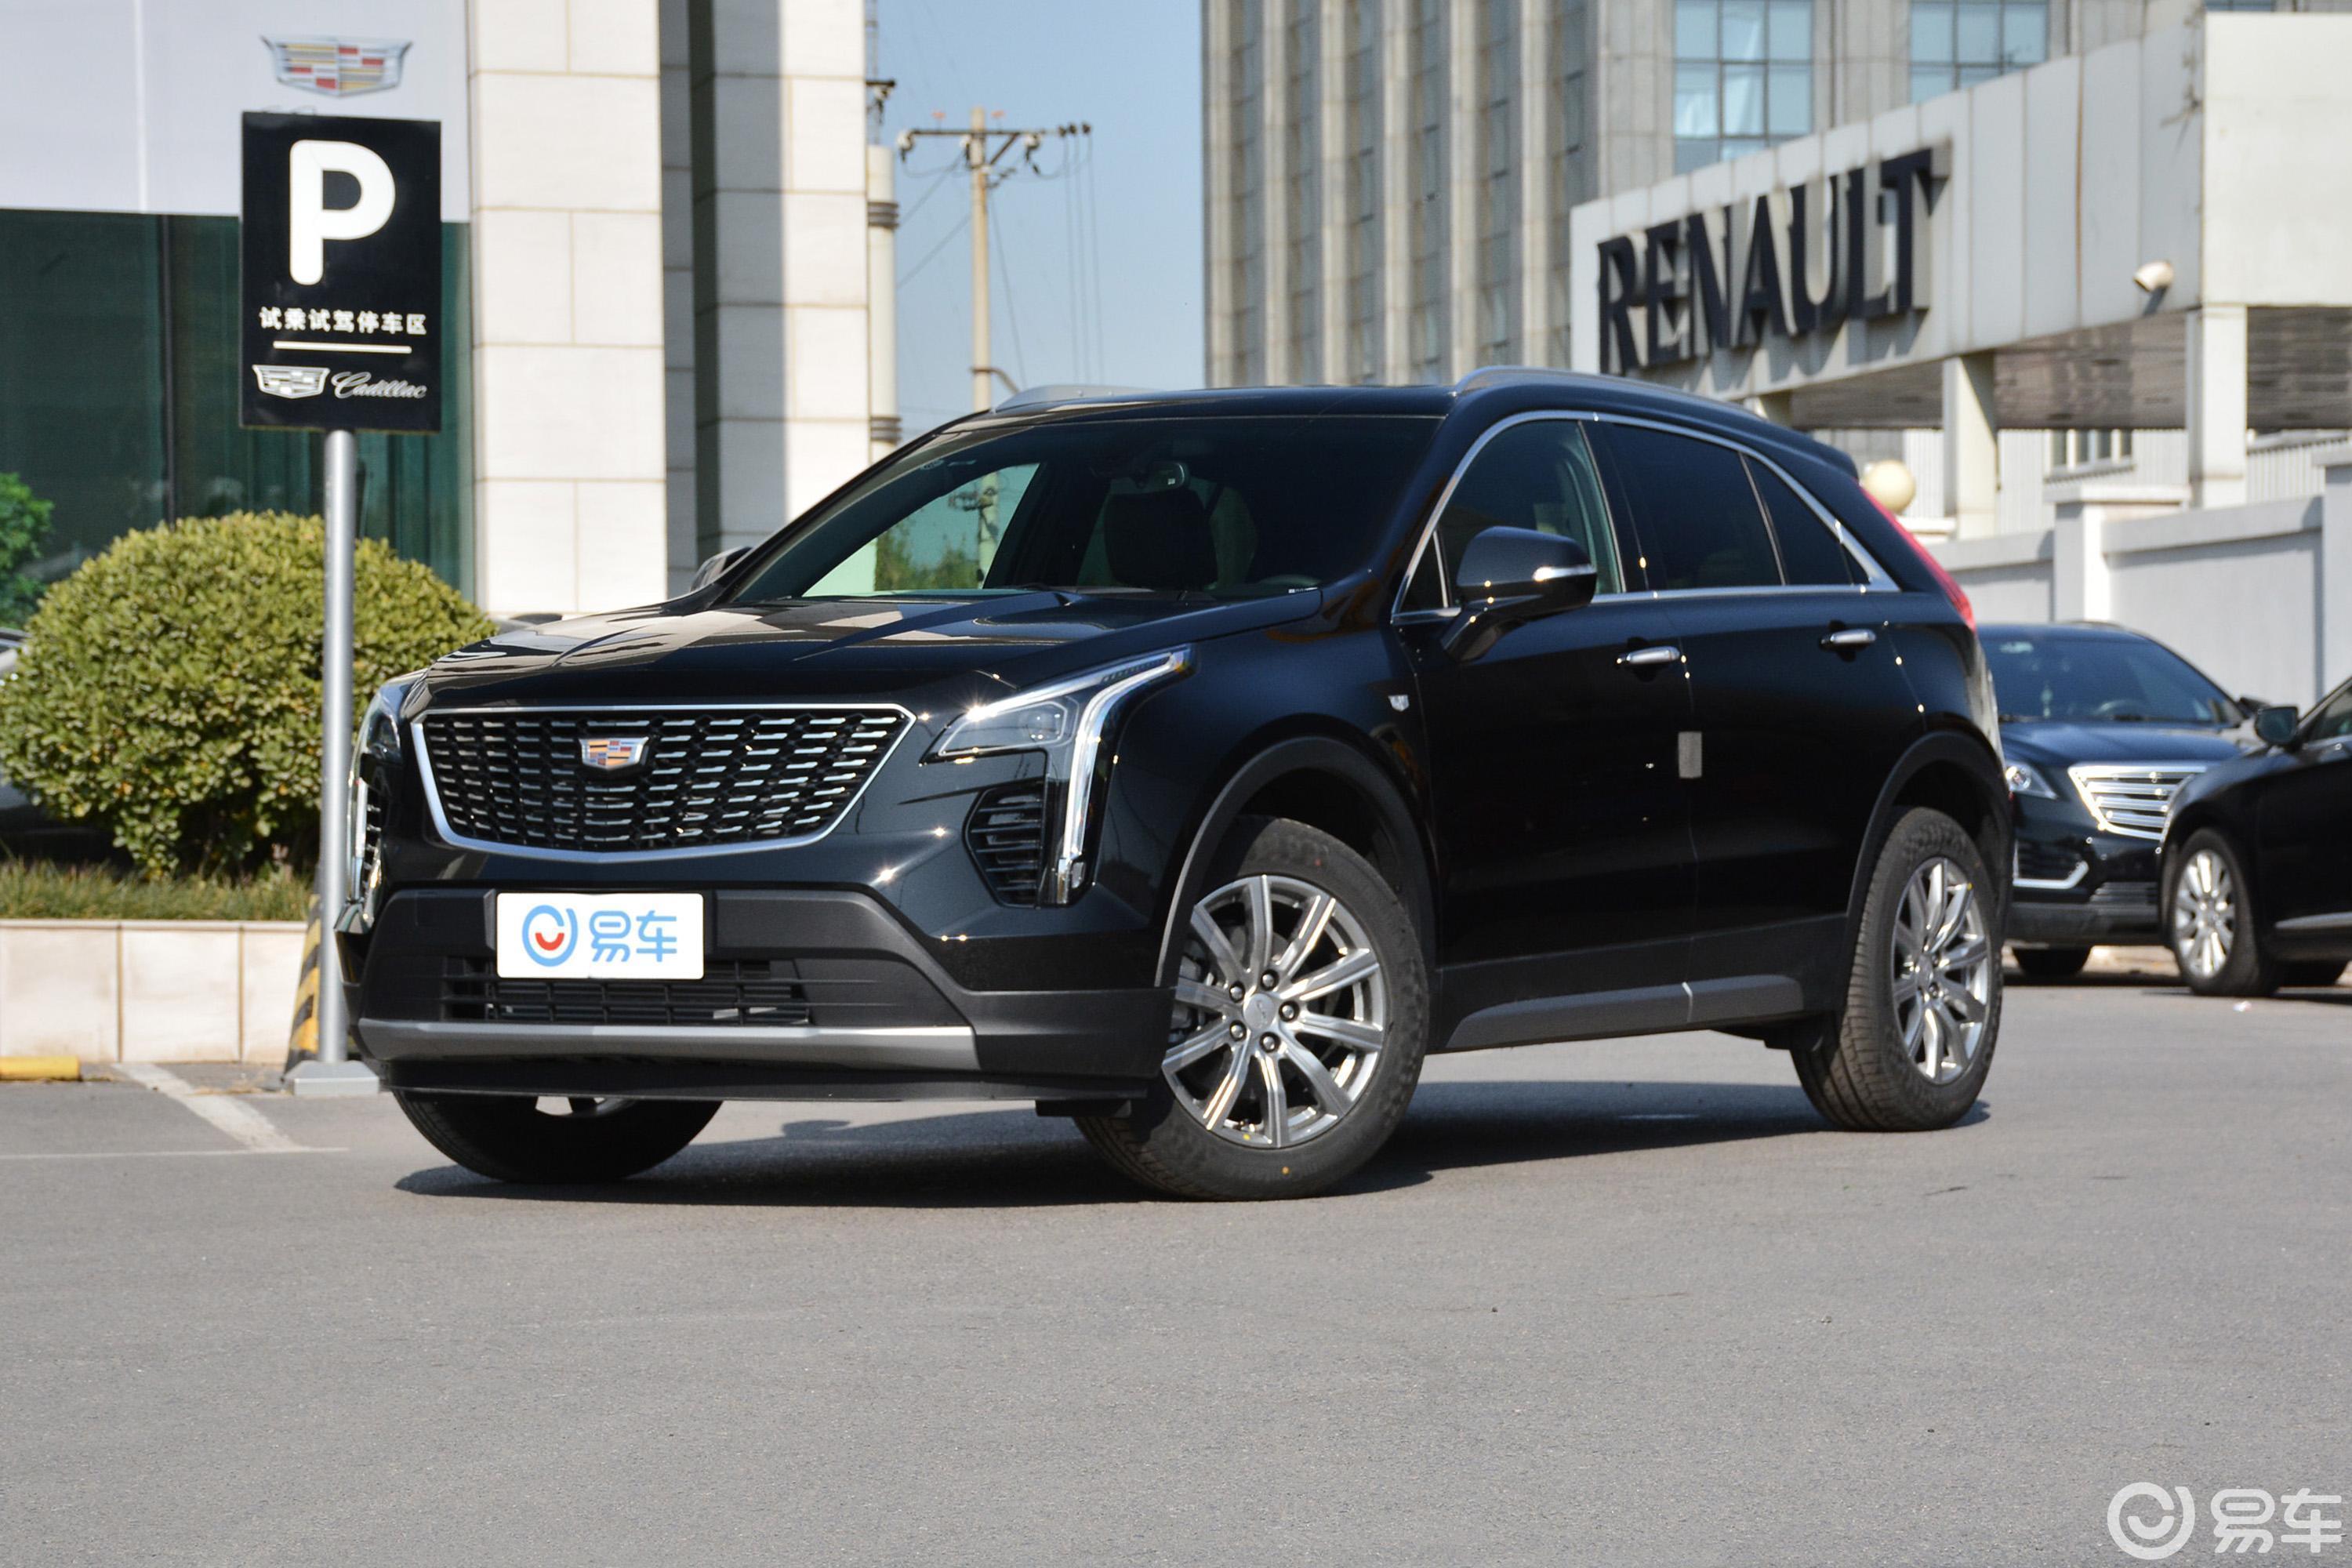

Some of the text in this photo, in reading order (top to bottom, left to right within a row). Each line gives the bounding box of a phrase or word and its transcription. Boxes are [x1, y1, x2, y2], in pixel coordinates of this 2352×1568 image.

[289, 140, 396, 285] P
[1597, 147, 1944, 375] RENAULT
[259, 306, 427, 336] 试乘试驾停车区
[331, 371, 427, 399] Cadillac
[589, 910, 677, 962] 易车
